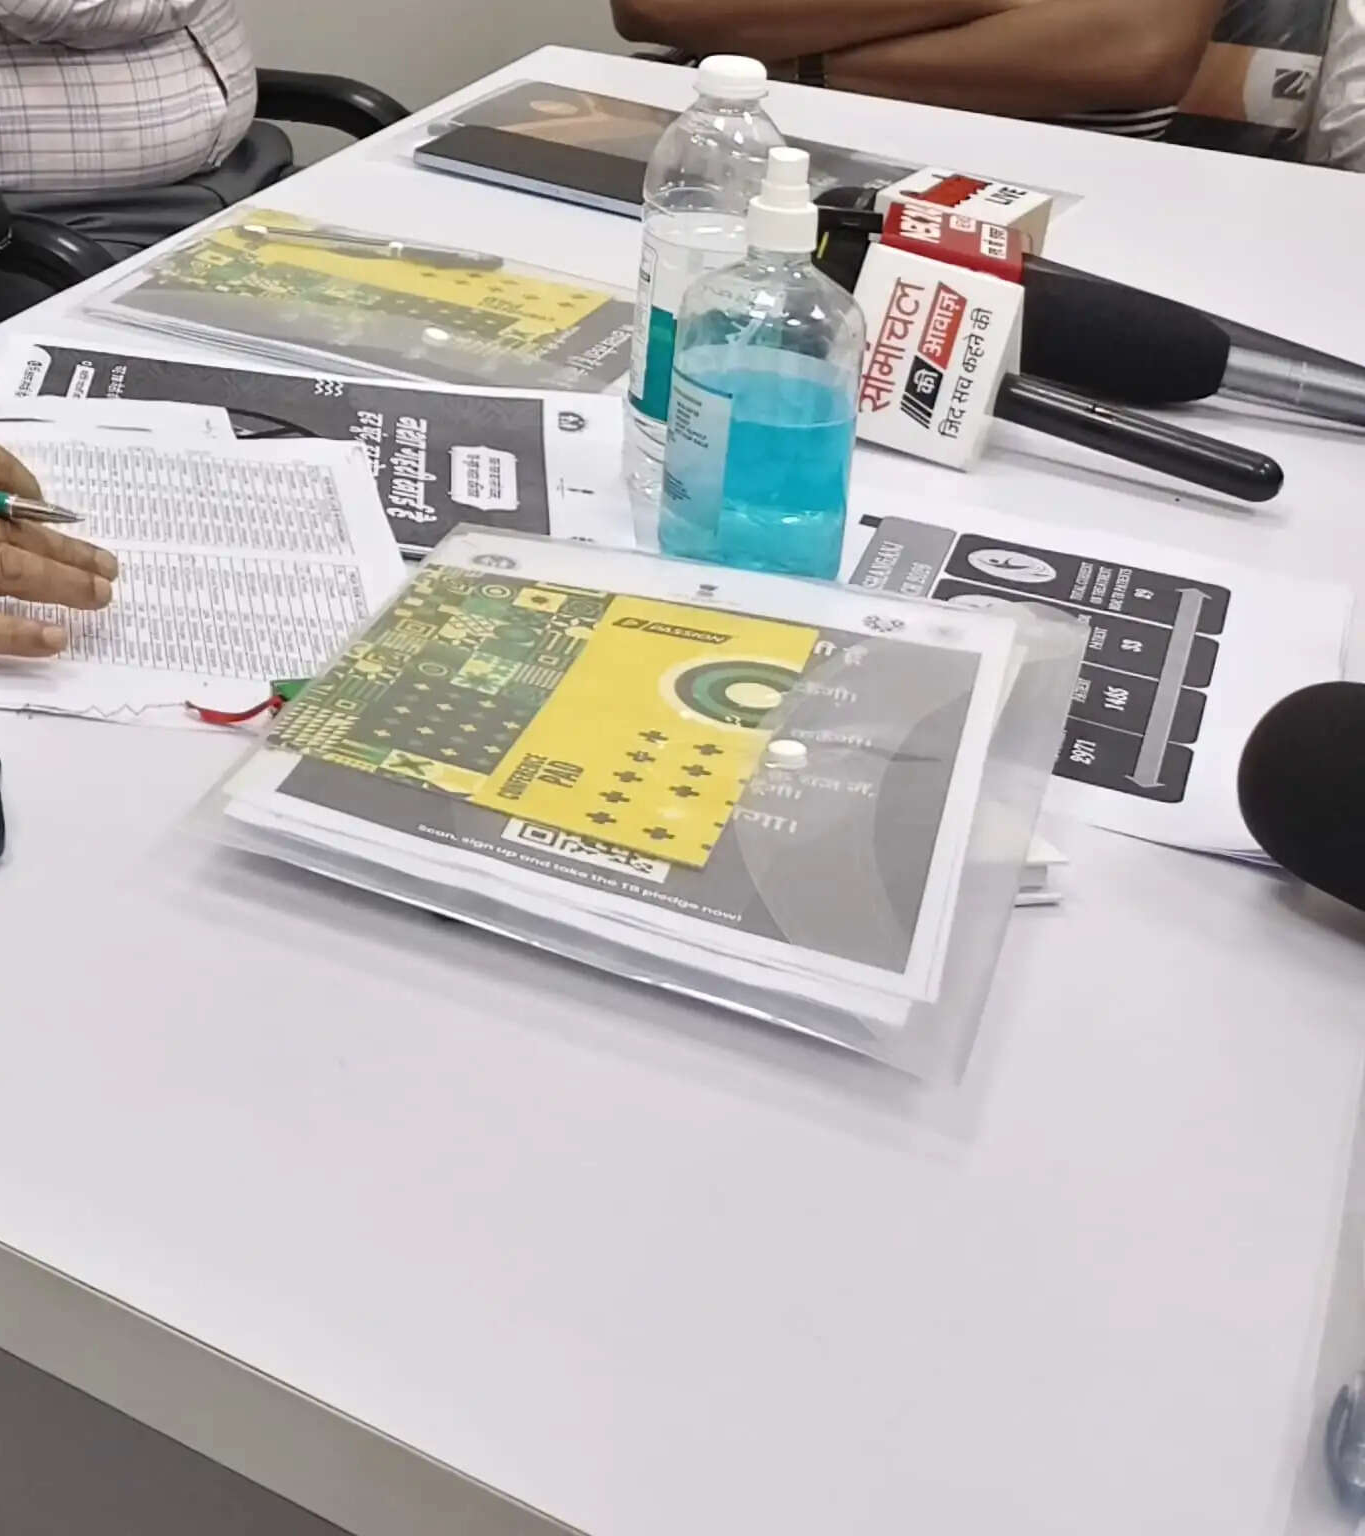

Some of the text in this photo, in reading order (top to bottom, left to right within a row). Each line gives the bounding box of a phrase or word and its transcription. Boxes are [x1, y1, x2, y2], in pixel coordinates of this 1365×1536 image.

[983, 186, 1030, 206] LIVE
[913, 292, 962, 395] की आवाज़
[649, 623, 726, 644] PASSION
[497, 752, 548, 800] CONFERENCE
[537, 760, 584, 789] PAD
[461, 835, 494, 854] sign
[495, 845, 518, 859] up
[519, 852, 552, 868] and
[553, 862, 589, 879] take
[591, 873, 618, 888] the
[621, 881, 641, 893] TB
[642, 888, 699, 911] pledge
